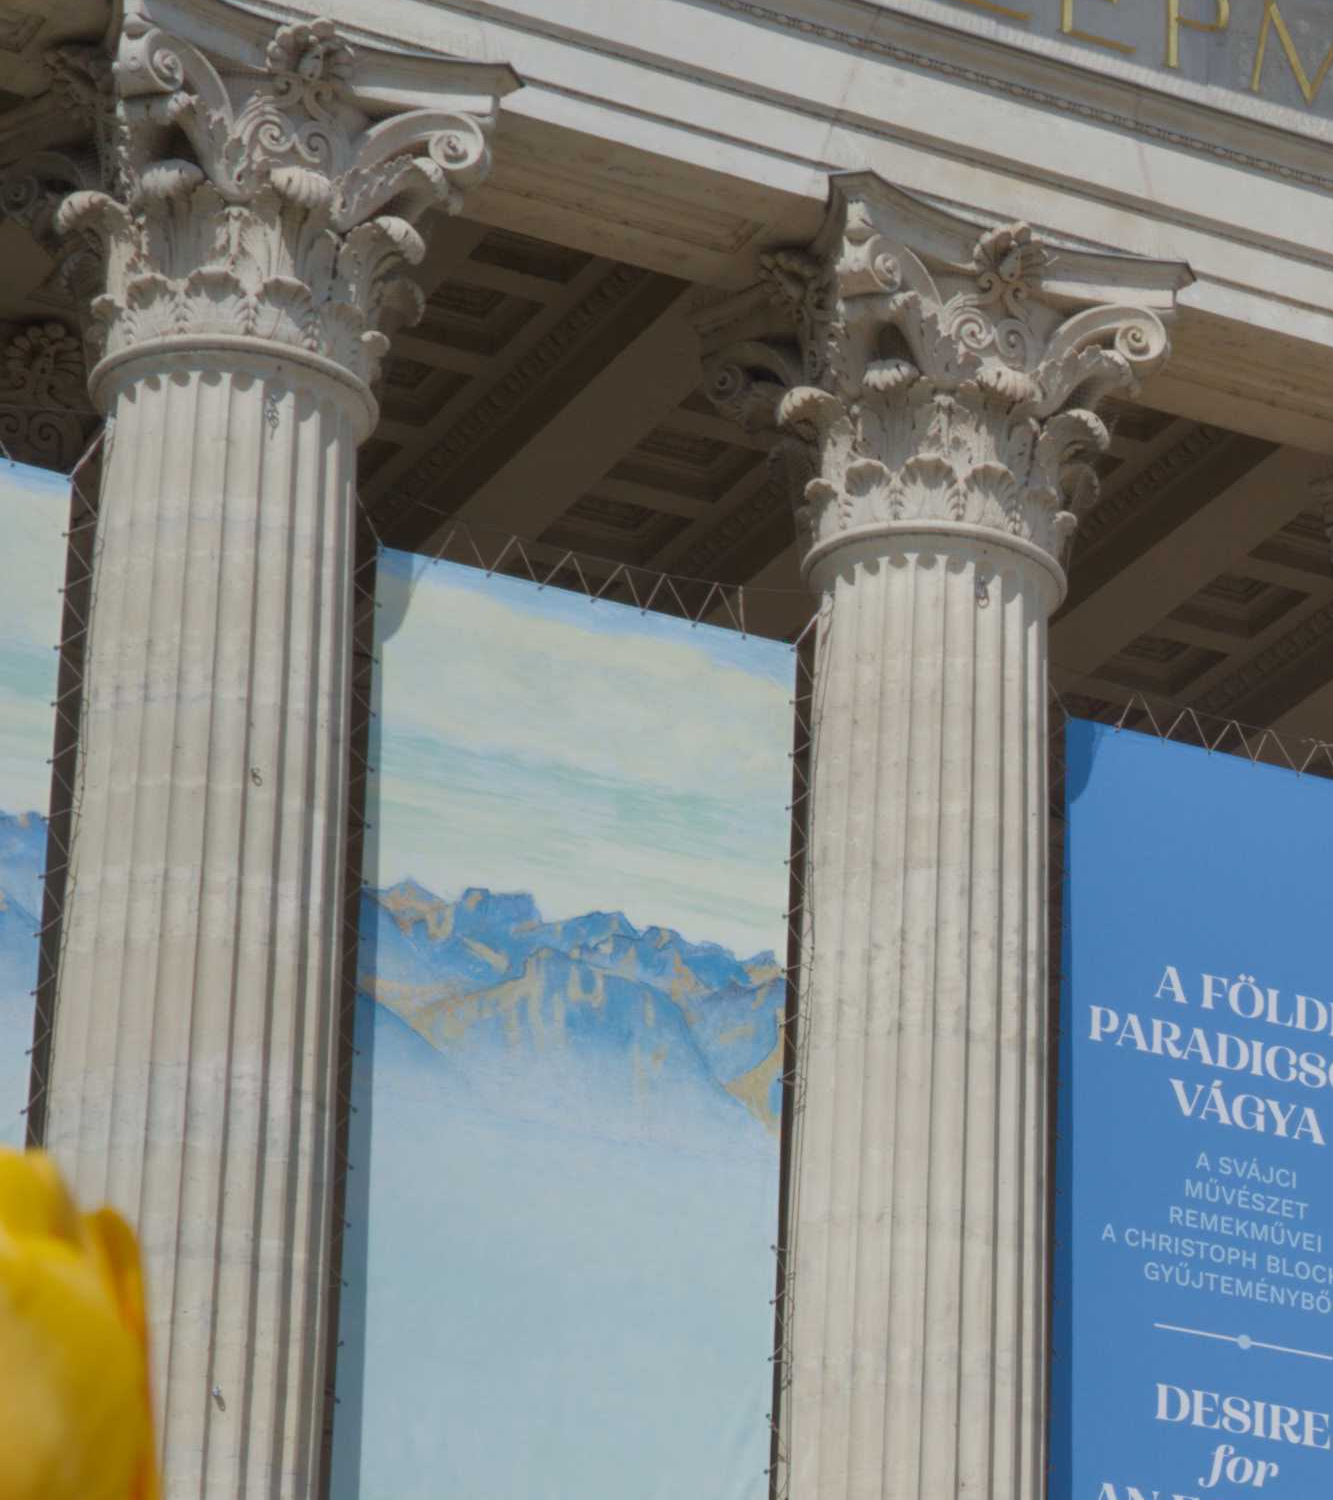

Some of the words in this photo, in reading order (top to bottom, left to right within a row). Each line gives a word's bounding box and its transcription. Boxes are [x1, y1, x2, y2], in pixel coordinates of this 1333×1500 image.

[1154, 966, 1188, 1004] A
[1169, 1078, 1326, 1146] VÁGYA
[1196, 1152, 1211, 1171] A
[1219, 1156, 1297, 1189] SVÁJCI
[1184, 1177, 1308, 1221] MŰVÉSZET
[1102, 1223, 1116, 1243] A
[1125, 1228, 1256, 1269] CHRISTOPH
[1169, 1206, 1322, 1253] REMEKMŰVEI
[1155, 1382, 1332, 1450] DESIRE
[1198, 1444, 1279, 1488] for
